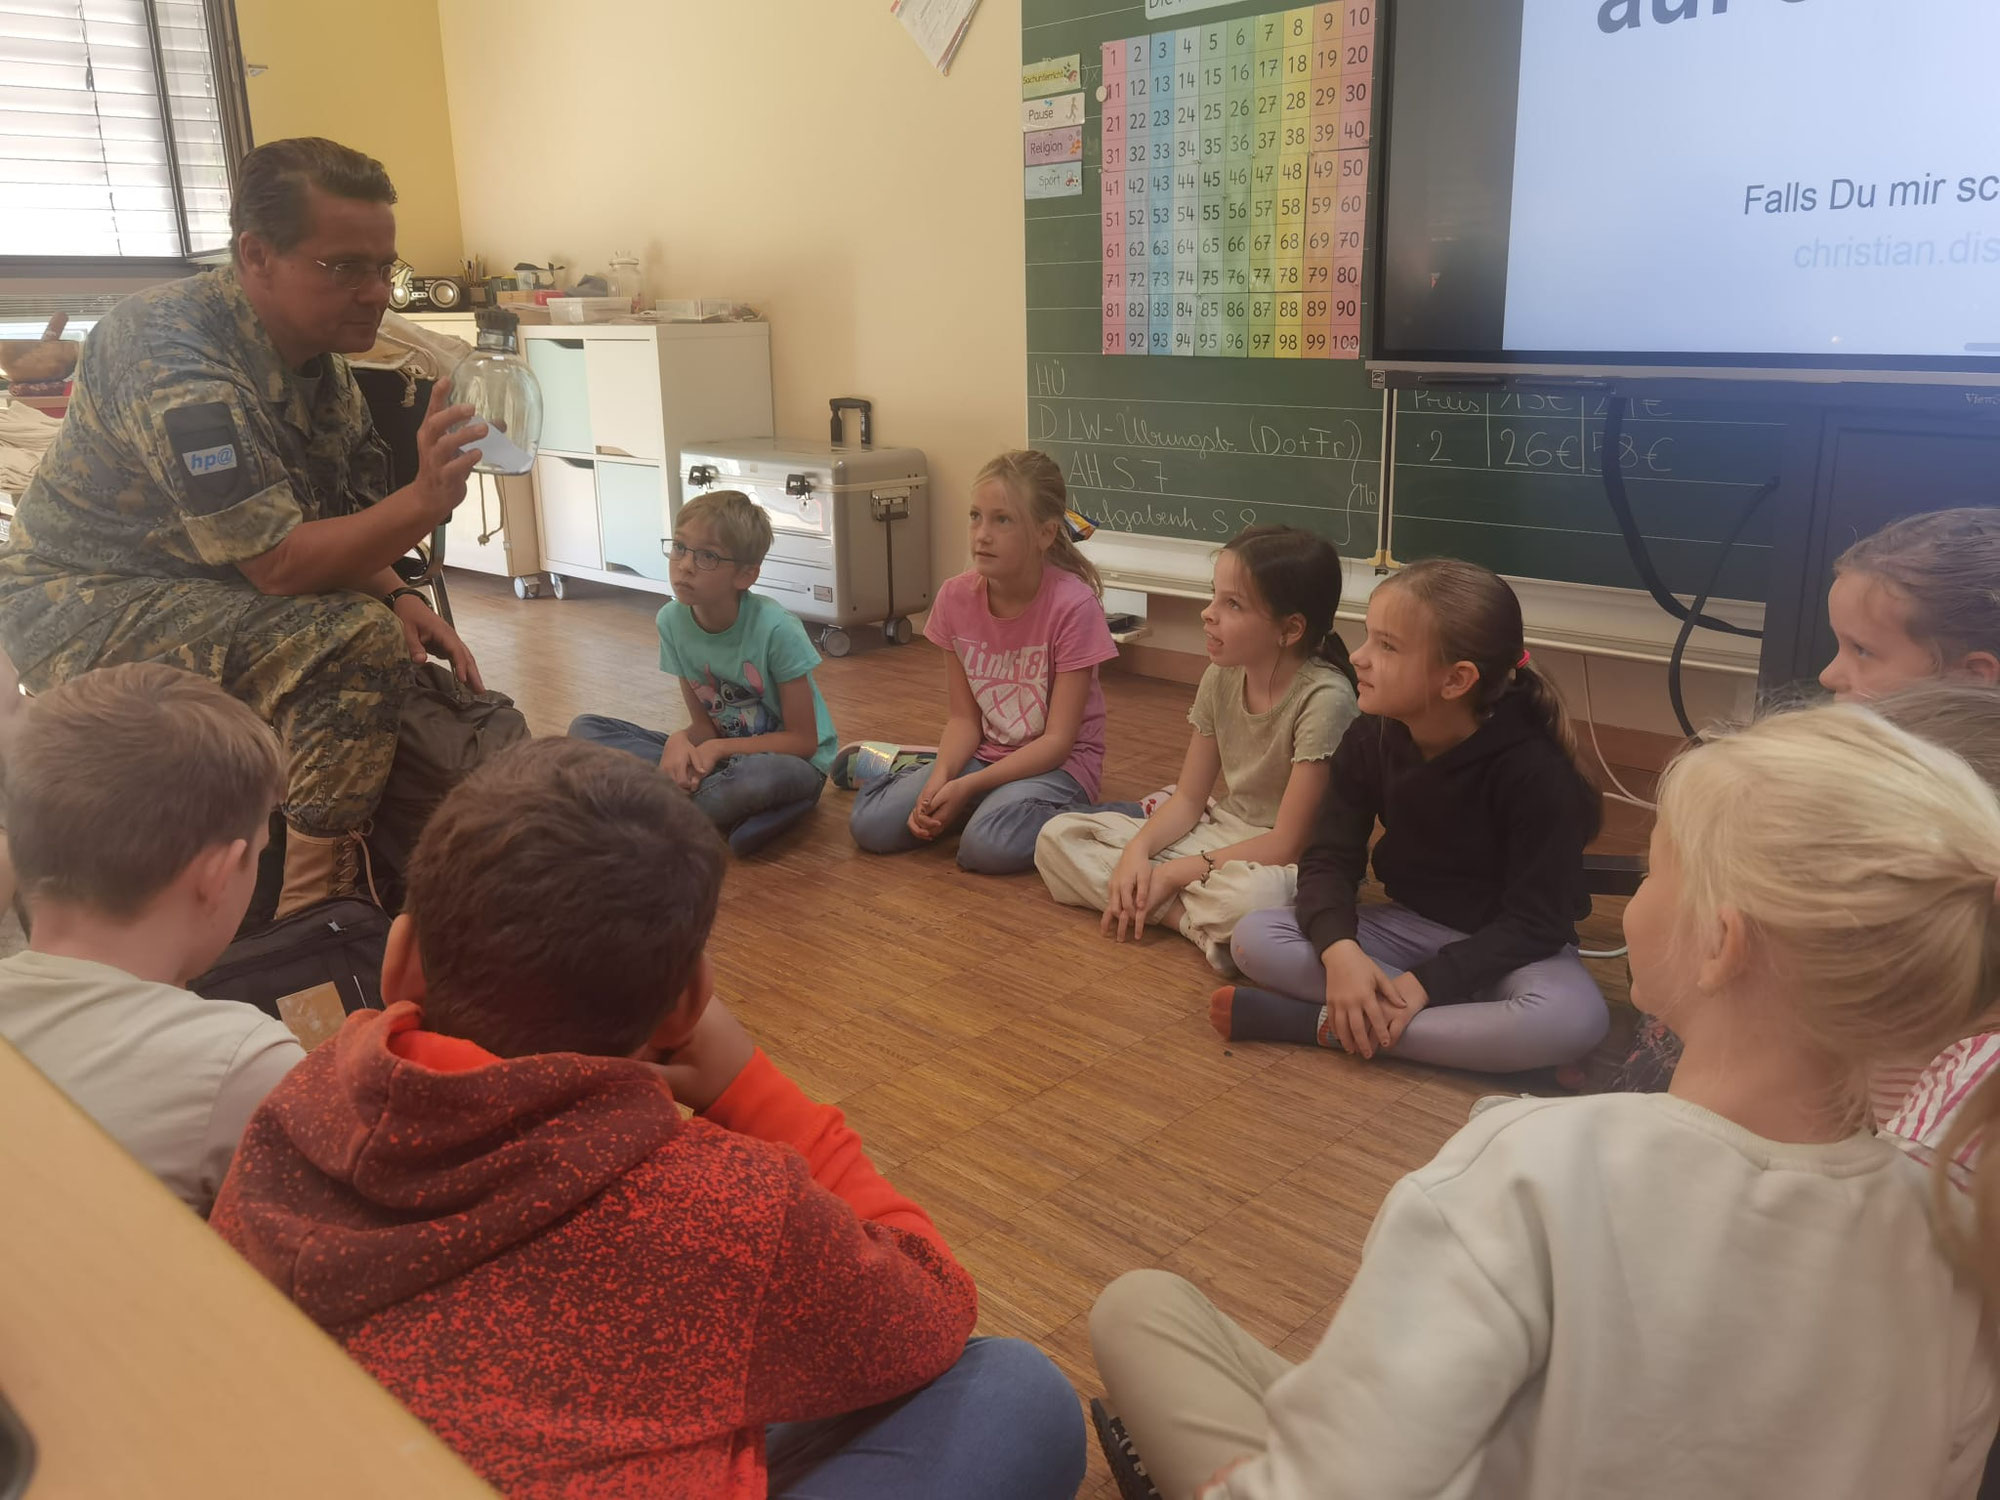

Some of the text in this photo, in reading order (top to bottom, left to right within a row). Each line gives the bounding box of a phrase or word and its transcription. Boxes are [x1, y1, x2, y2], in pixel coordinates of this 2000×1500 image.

[1134, 46, 1142, 62] 2
[1158, 42, 1166, 59] 3
[1183, 38, 1192, 54] 4
[1209, 33, 1218, 50] 5
[1236, 28, 1245, 46] 6
[1265, 23, 1274, 42] 7
[1293, 18, 1303, 36] 8
[1324, 12, 1333, 31] 9
[1350, 7, 1370, 27] 10
[1107, 45, 1368, 99] 11 12 13 14 15 16 17 18 19 20
[1028, 109, 1054, 121] Pause
[1106, 83, 1366, 132] 21 22 23 24 25 26 27 28 29 30
[1030, 142, 1063, 157] Religion
[1106, 120, 1365, 164] 31 32 33 34 35 36 37 38 39 40
[1038, 174, 1061, 192] Sport
[1105, 158, 1363, 196] 41 42 43 44 45 46 47 48 49 50
[1744, 172, 2000, 216] Falls Du mir sc
[1106, 195, 1361, 227] 51 52 53 54 55 56 57 58 59 60
[1106, 231, 1359, 258] 61 62 63 64 65 66 67 68 69 70
[1793, 230, 2000, 269] christian.dis
[1106, 265, 1357, 288] 71 72 73 74 75 76 77 78 79 80
[1106, 300, 1356, 318] 81 82 83 84 85 86 87 88 89 90
[1106, 331, 1359, 350] 91 92 93 94 95 96 97 98 99 100
[1035, 359, 1066, 396] HÜ
[1038, 403, 1058, 440] D
